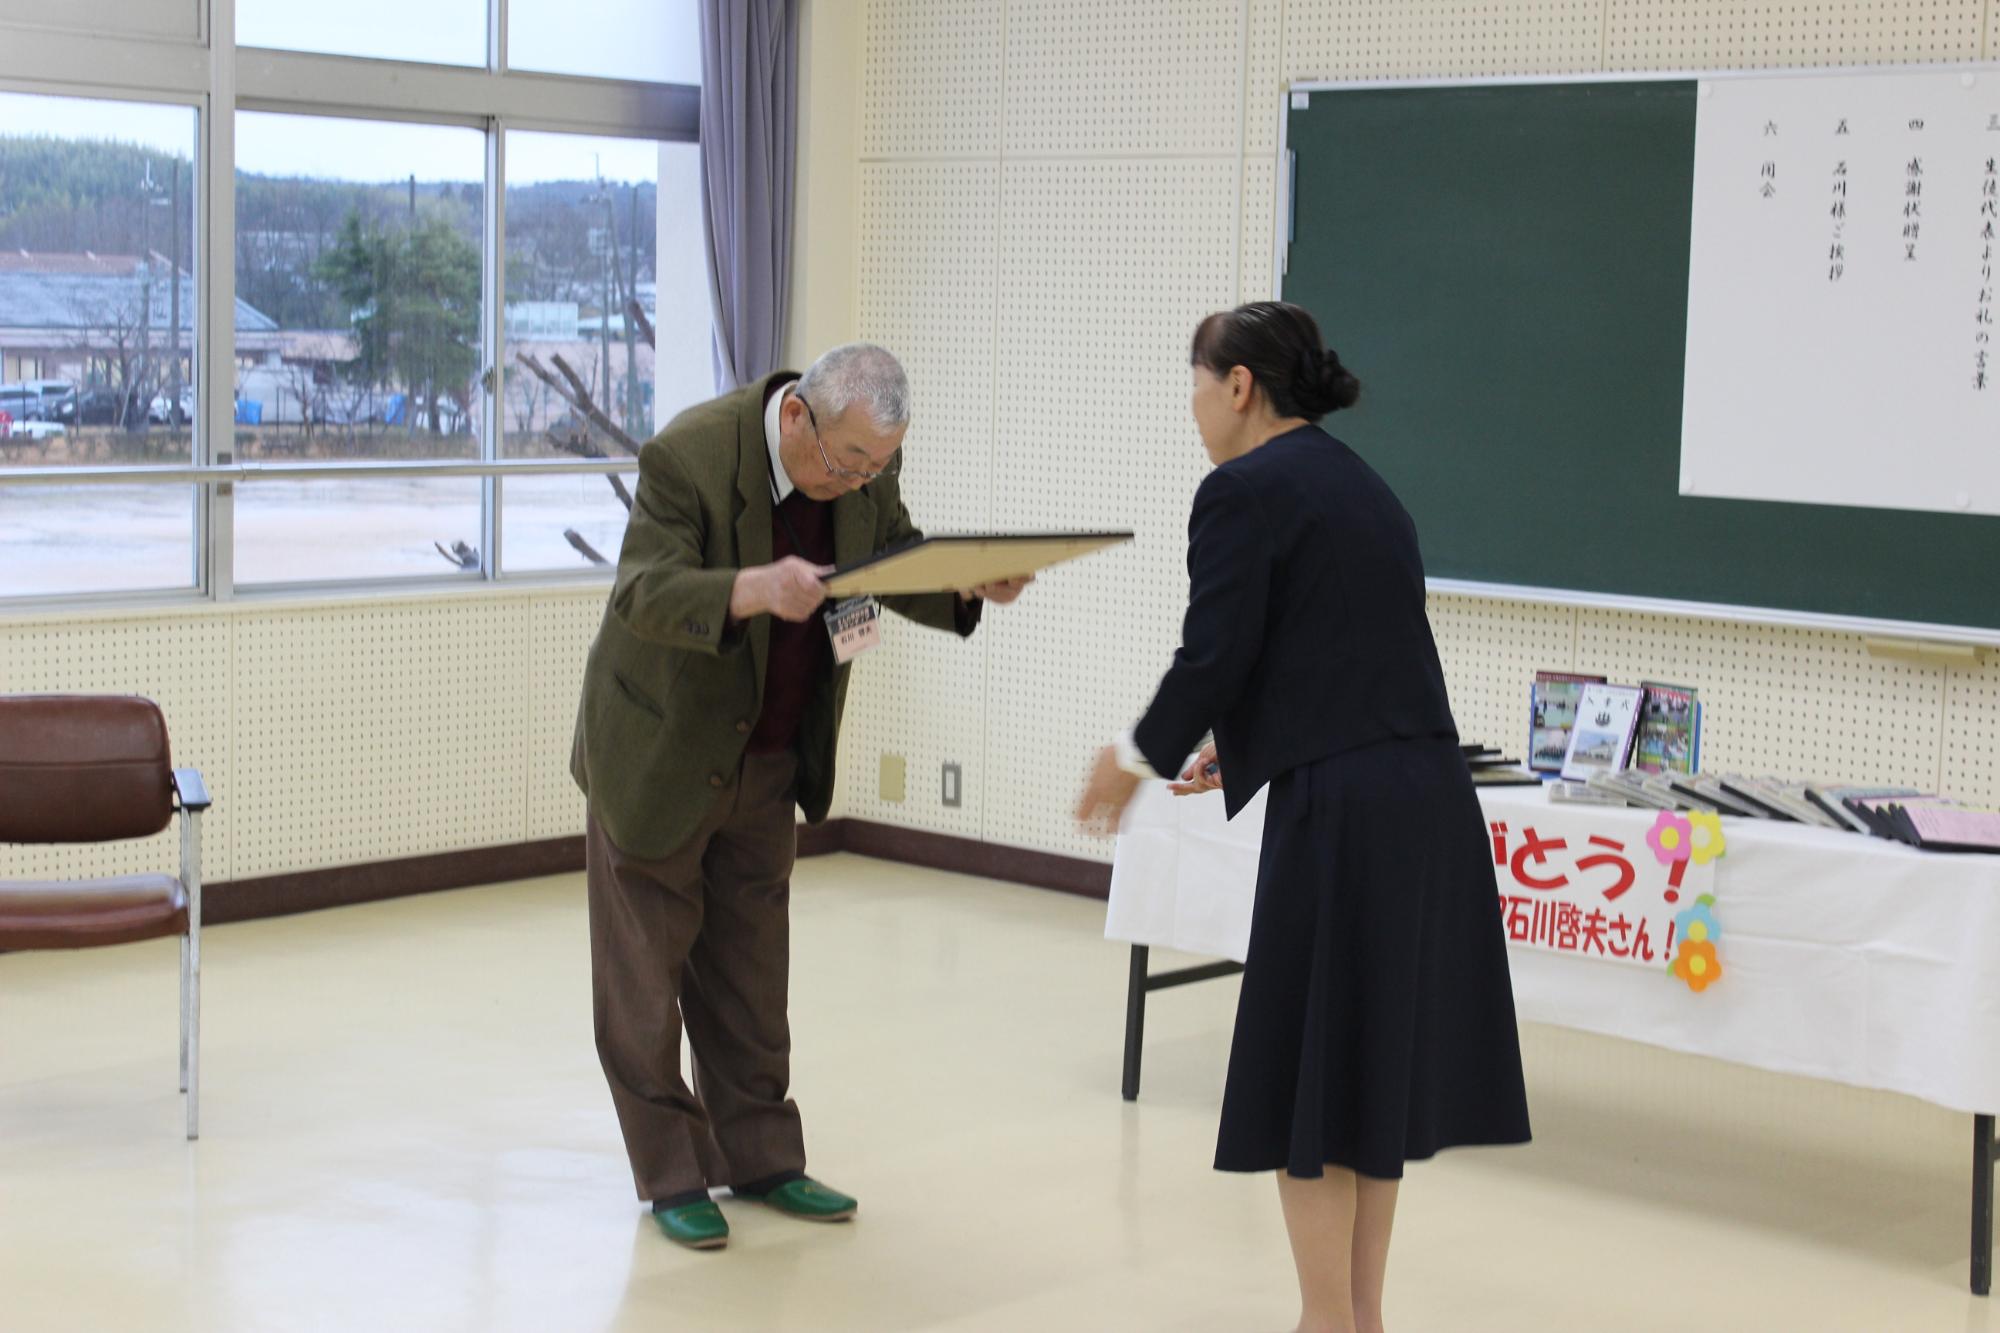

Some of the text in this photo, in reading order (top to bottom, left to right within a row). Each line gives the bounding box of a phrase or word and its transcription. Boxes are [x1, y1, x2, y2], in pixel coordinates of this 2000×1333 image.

[1903, 119, 1924, 261] 四 感謝状贈呈
